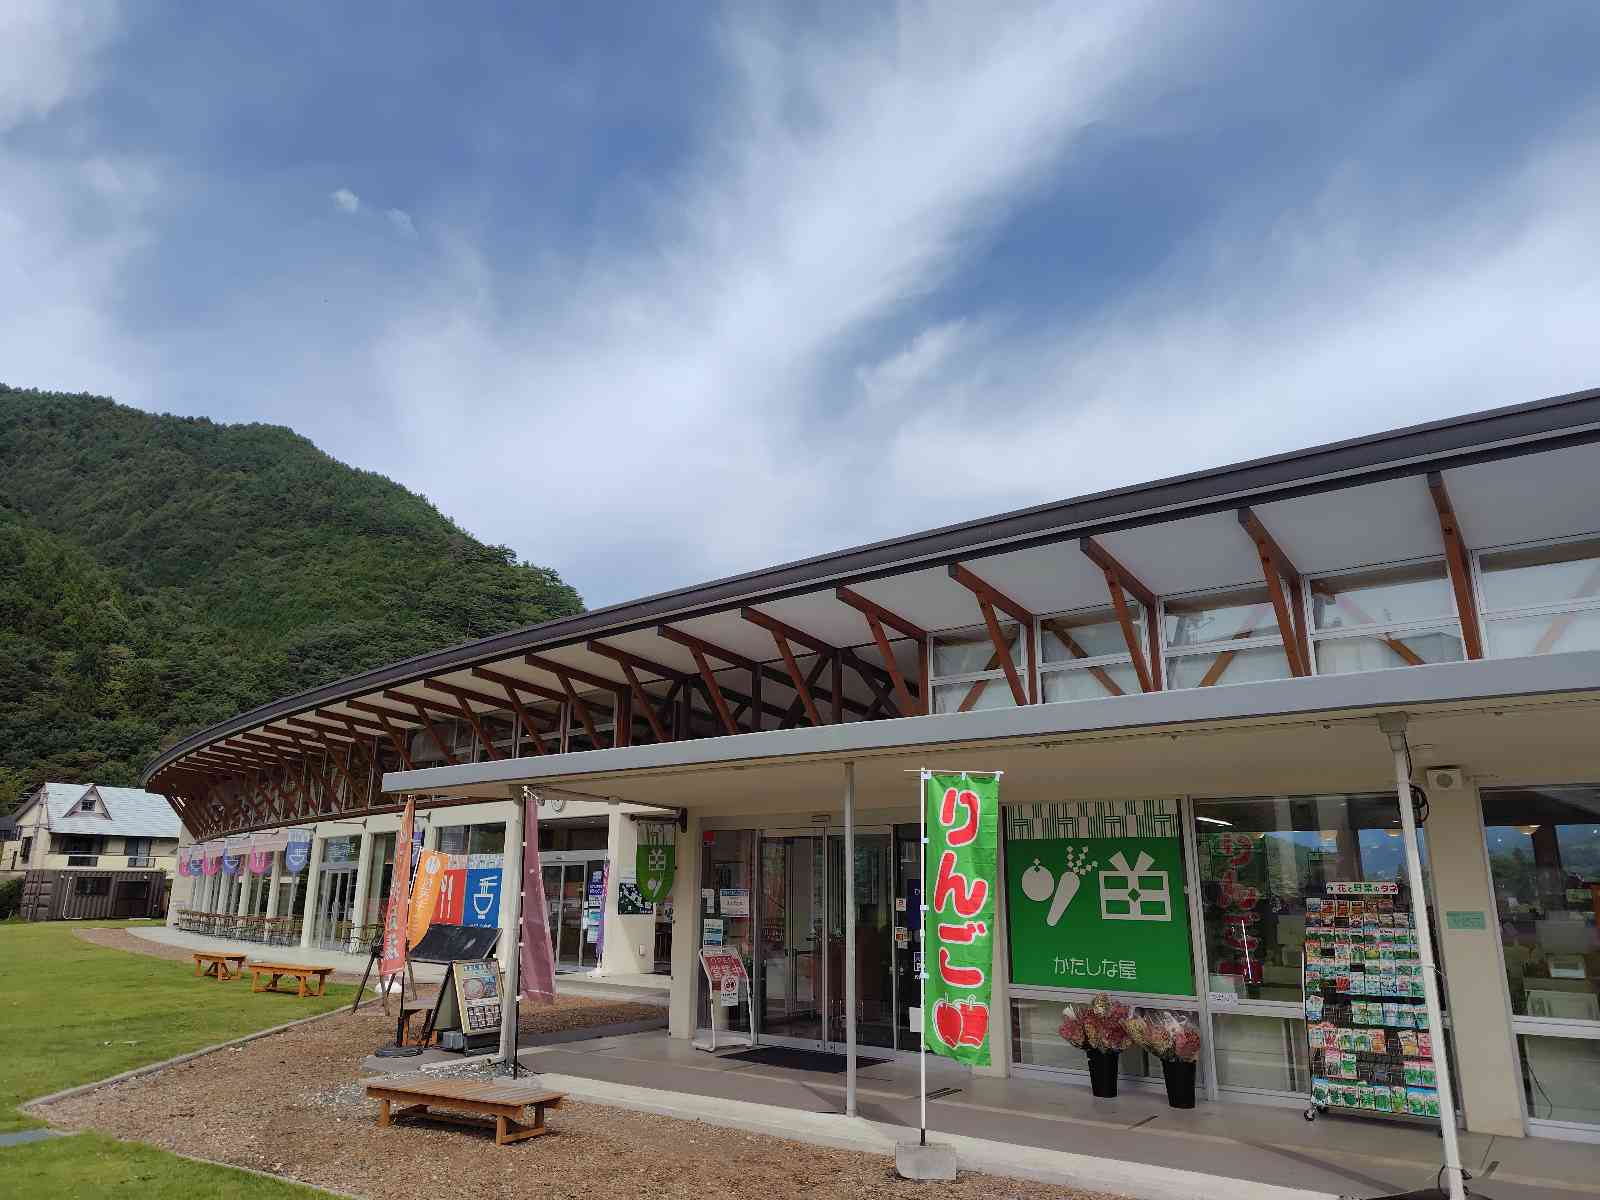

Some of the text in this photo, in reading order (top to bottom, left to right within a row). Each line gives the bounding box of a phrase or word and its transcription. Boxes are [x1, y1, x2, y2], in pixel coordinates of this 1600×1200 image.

[934, 787, 989, 989] りんご
[1054, 953, 1137, 980] かたしな屋
